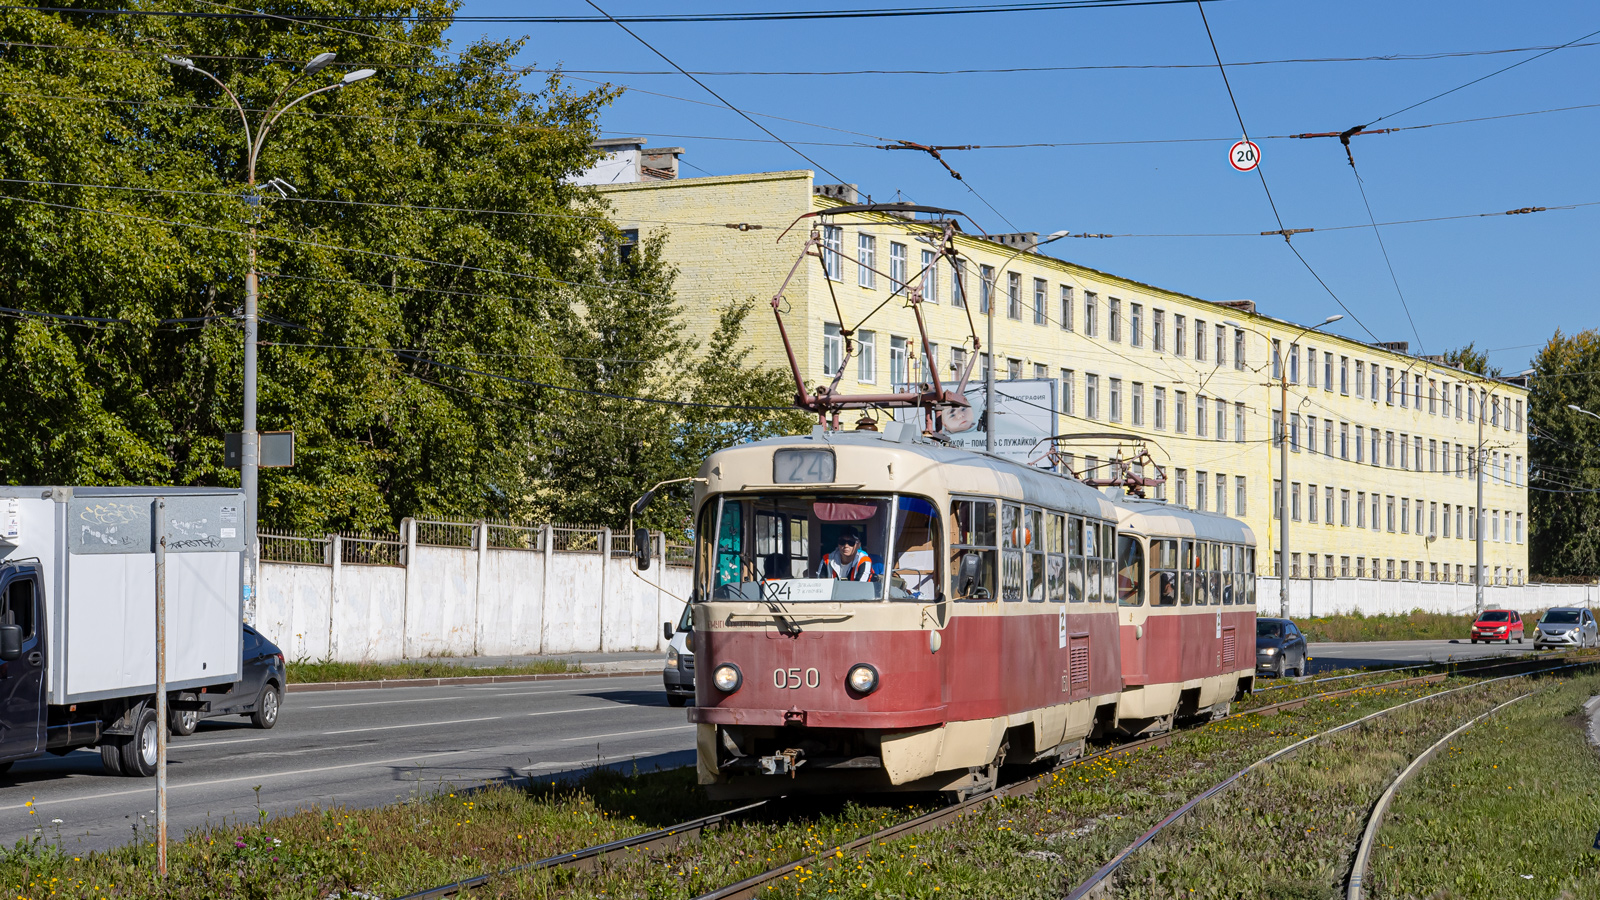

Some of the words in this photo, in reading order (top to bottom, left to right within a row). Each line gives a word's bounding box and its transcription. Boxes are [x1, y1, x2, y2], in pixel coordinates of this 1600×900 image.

[1236, 149, 1254, 162] 20
[971, 439, 998, 447] ПОМОЬ
[788, 452, 823, 482] 24
[767, 581, 791, 600] 24
[773, 667, 821, 690] 050
